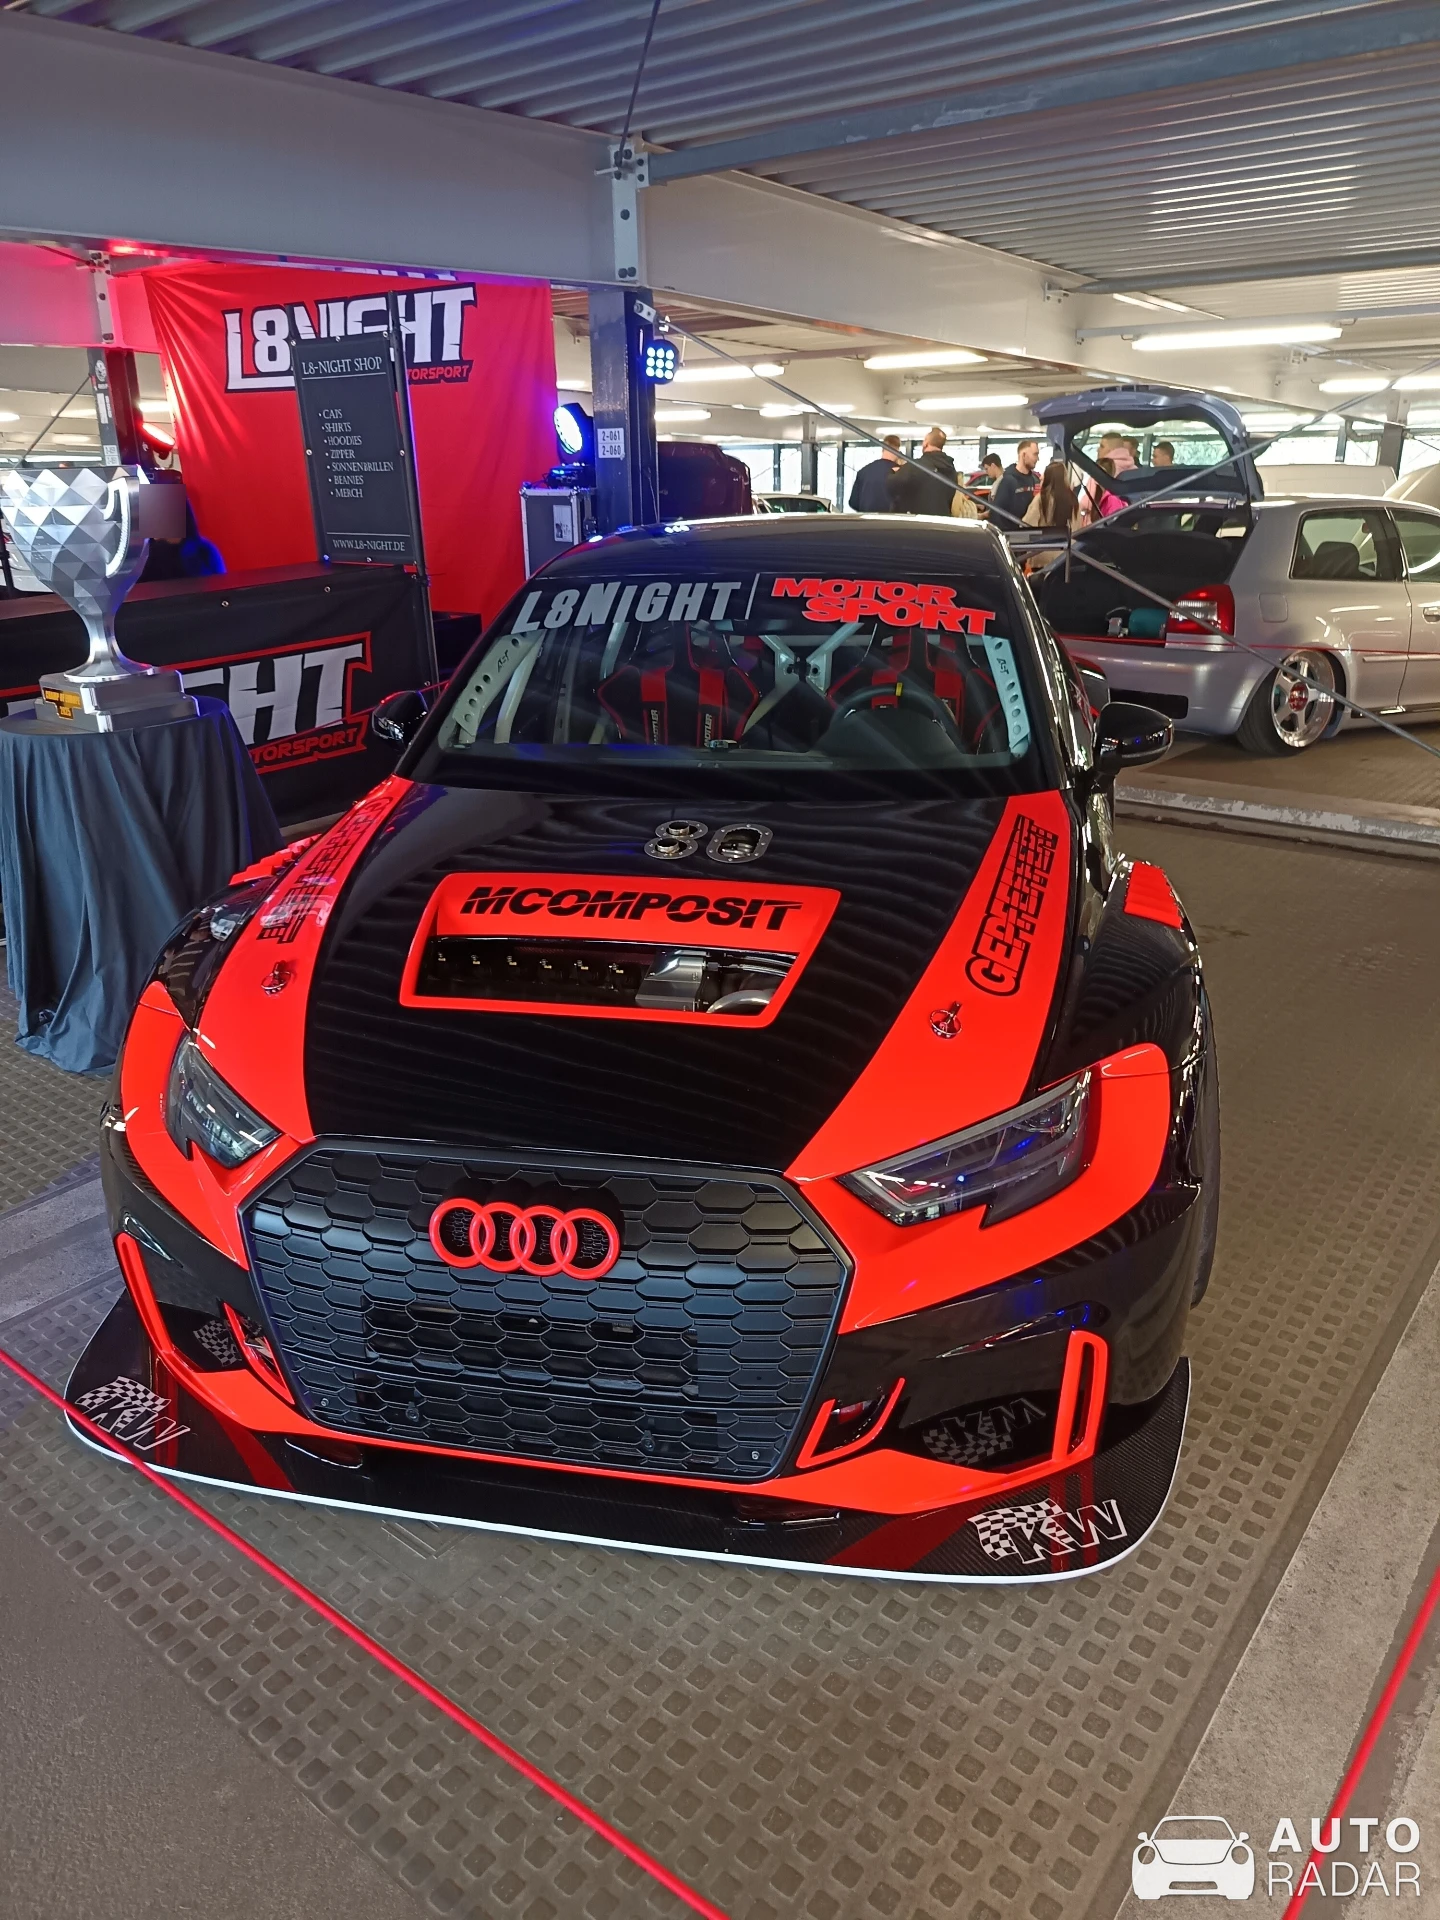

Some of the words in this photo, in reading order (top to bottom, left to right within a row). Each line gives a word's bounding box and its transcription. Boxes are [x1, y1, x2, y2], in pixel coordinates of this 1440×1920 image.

[302, 359, 351, 375] L8-NIGHT
[353, 356, 382, 371] SHOP
[407, 364, 469, 380] TORSPORT
[322, 409, 343, 419] CAPS
[324, 422, 352, 432] SHIRTS
[327, 435, 362, 446] HOODIES
[602, 430, 620, 441] 2-061
[330, 449, 355, 459] ZIPPER
[331, 462, 394, 472] SONNENBRILLEN
[333, 475, 364, 485] BEANIES
[335, 488, 363, 498] MERCH
[771, 577, 957, 607] MOTOR
[511, 581, 742, 634] L8NIGHT
[801, 597, 996, 635] SPORT
[250, 727, 358, 764] TORSPORT
[460, 886, 804, 931] MCOMPOSIT
[1005, 1499, 1127, 1564] KW
